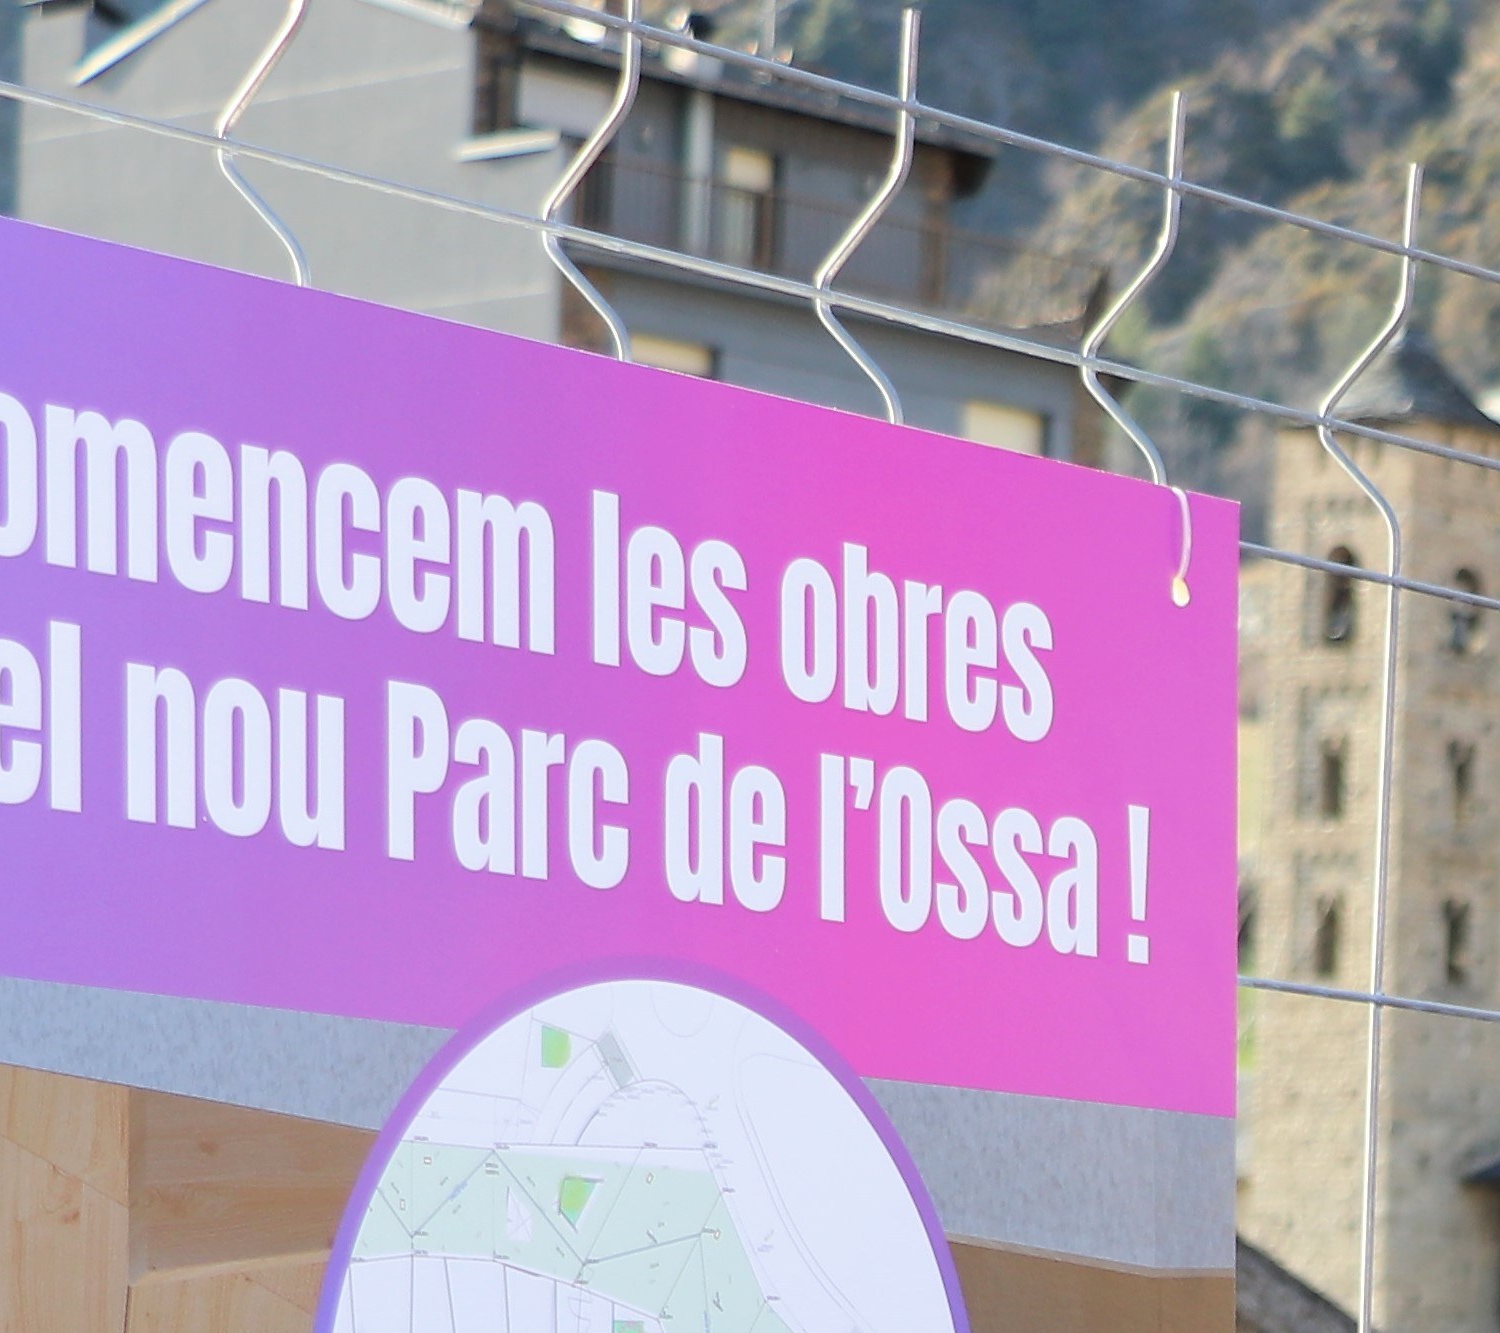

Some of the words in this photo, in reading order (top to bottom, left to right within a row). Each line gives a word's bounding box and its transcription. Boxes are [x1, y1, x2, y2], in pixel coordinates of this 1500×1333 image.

[592, 489, 747, 687] les
[780, 542, 1054, 742] obres
[125, 661, 345, 851] nou
[387, 679, 629, 889] Parc
[664, 732, 786, 912] de
